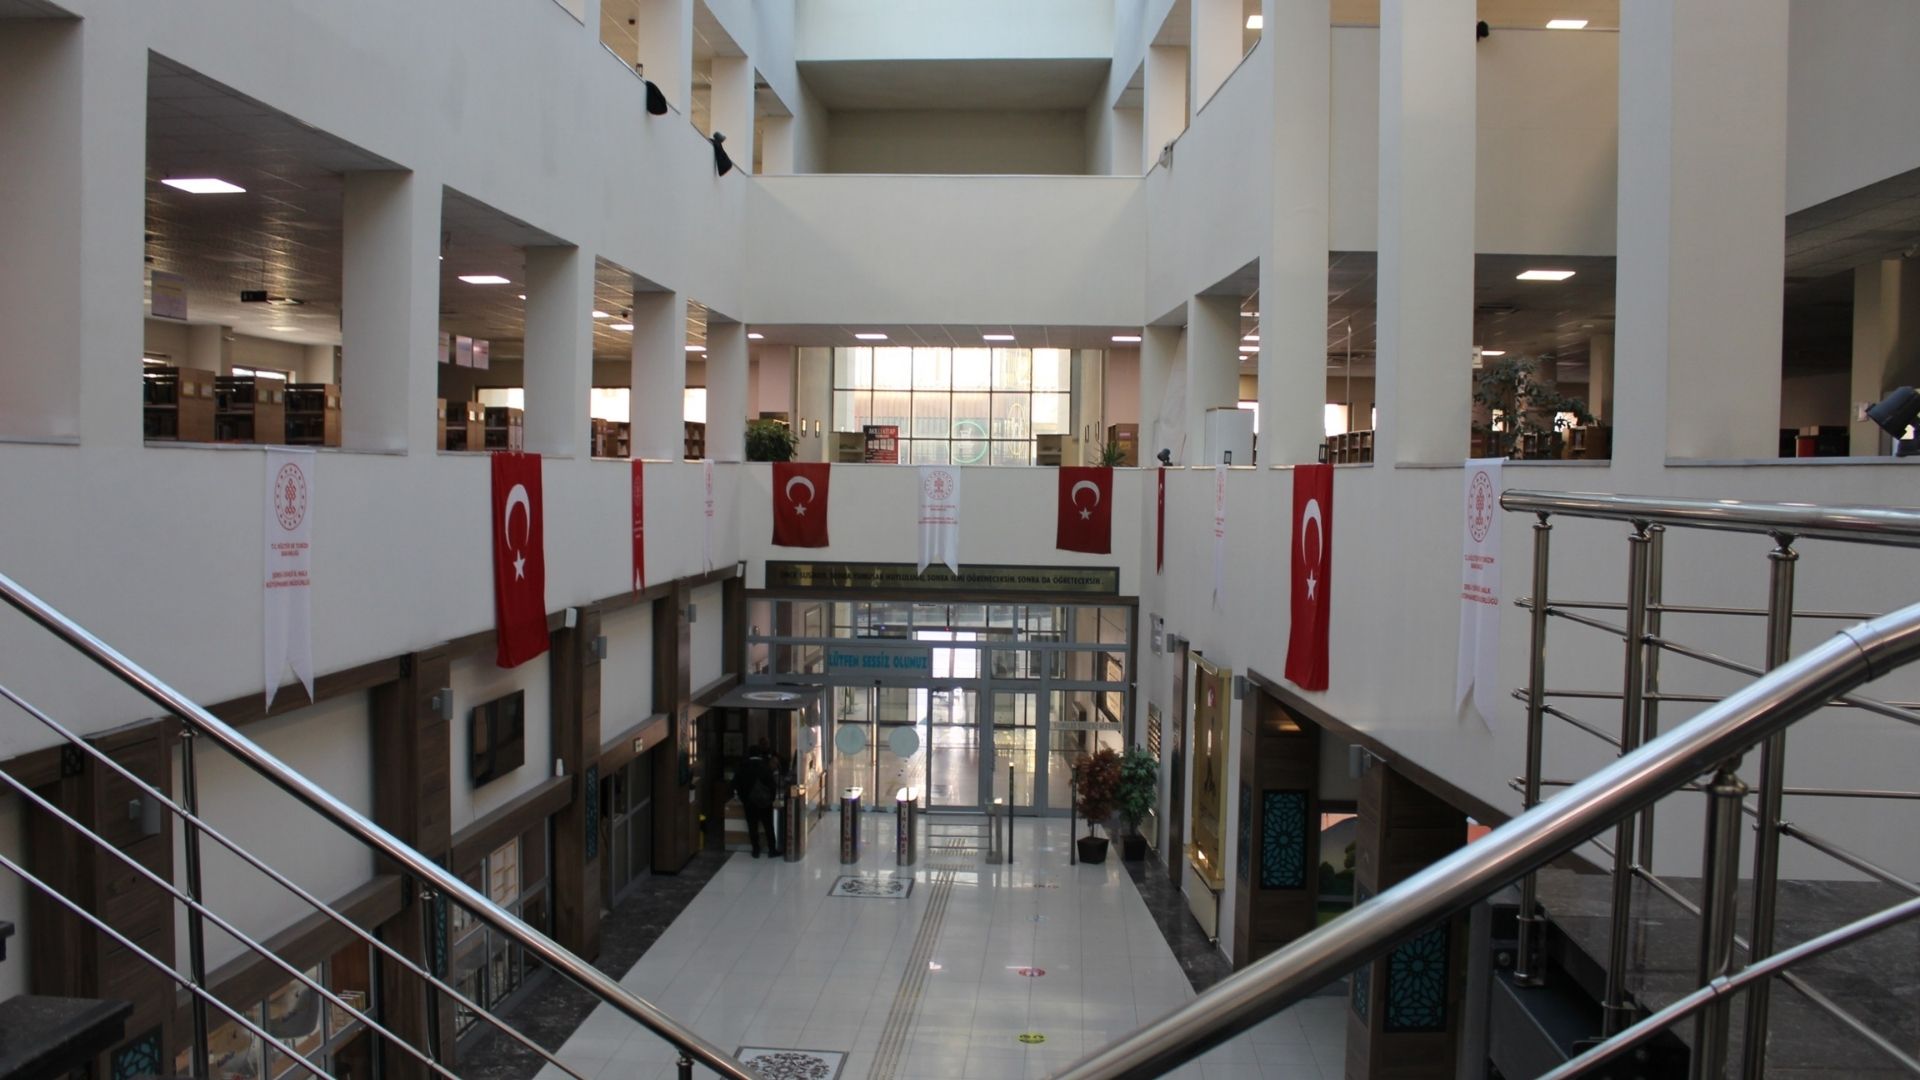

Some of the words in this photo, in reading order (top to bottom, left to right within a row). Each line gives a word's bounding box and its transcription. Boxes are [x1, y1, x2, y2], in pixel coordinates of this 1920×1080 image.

[829, 651, 859, 667] LÜTFEN
[862, 651, 889, 668] SESSİZ
[893, 655, 928, 668] OLUNUZ
